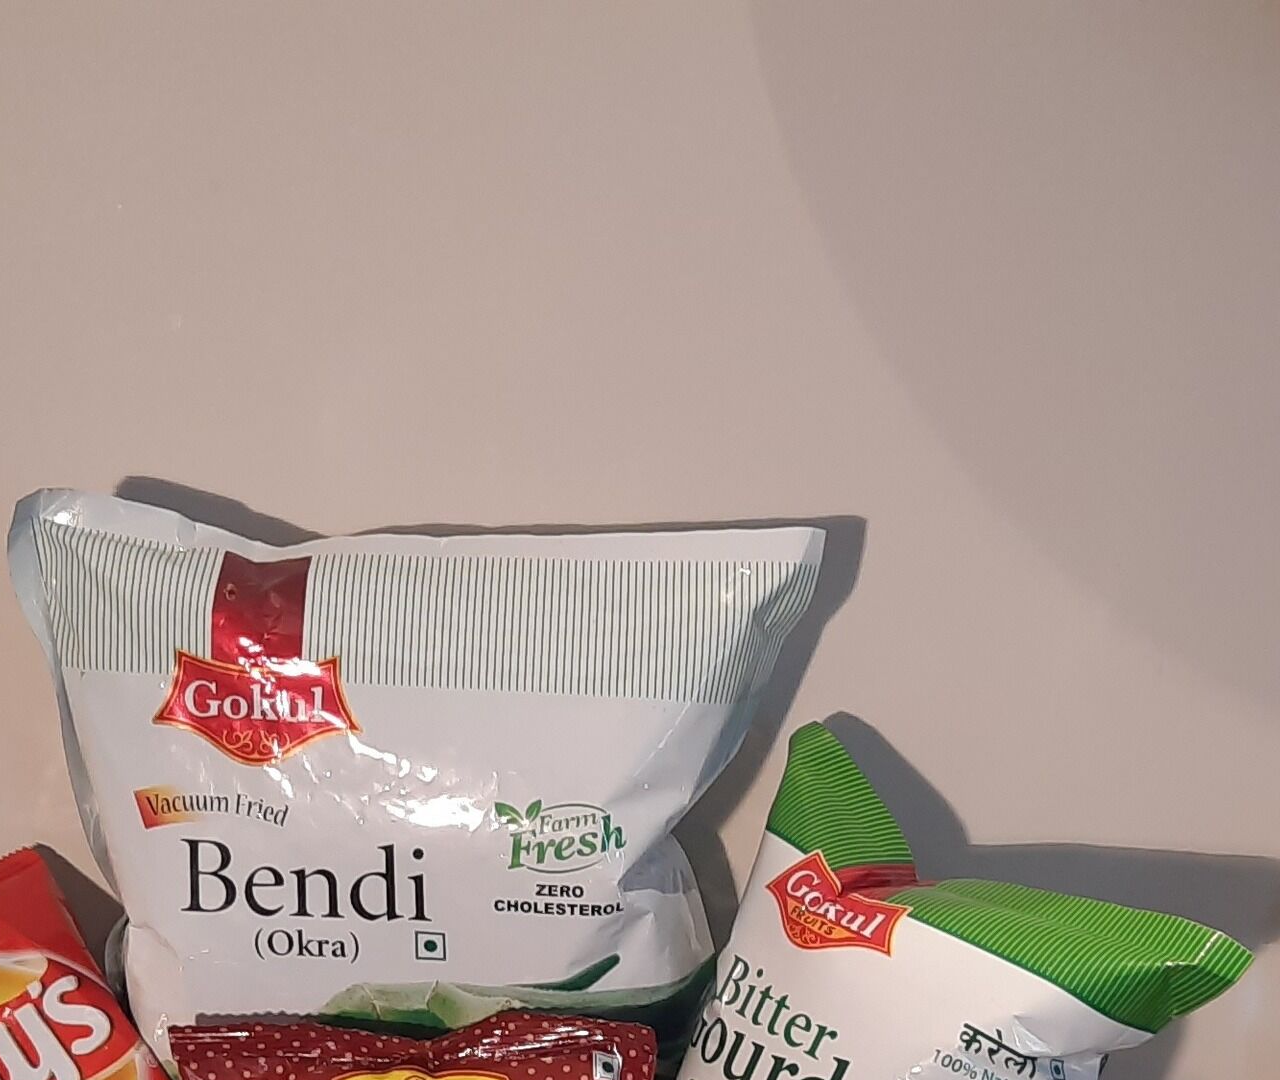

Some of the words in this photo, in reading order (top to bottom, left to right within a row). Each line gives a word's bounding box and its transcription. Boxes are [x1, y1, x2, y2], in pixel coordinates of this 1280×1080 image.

[184, 680, 326, 723] Gokul
[145, 793, 229, 816] Vacuum
[235, 793, 289, 827] Fried
[539, 812, 598, 834] Farm
[508, 813, 627, 870] Fresh
[180, 838, 432, 922] Bendi
[535, 884, 584, 898] ZERO
[494, 899, 624, 916] CHOLESTEROL
[787, 870, 887, 939] Gokul
[790, 905, 836, 936] FRUITS
[254, 928, 360, 964] (Okra)
[715, 954, 838, 1060] Bitter
[932, 1049, 978, 1079] 100%
[960, 1023, 1038, 1079] करेला
